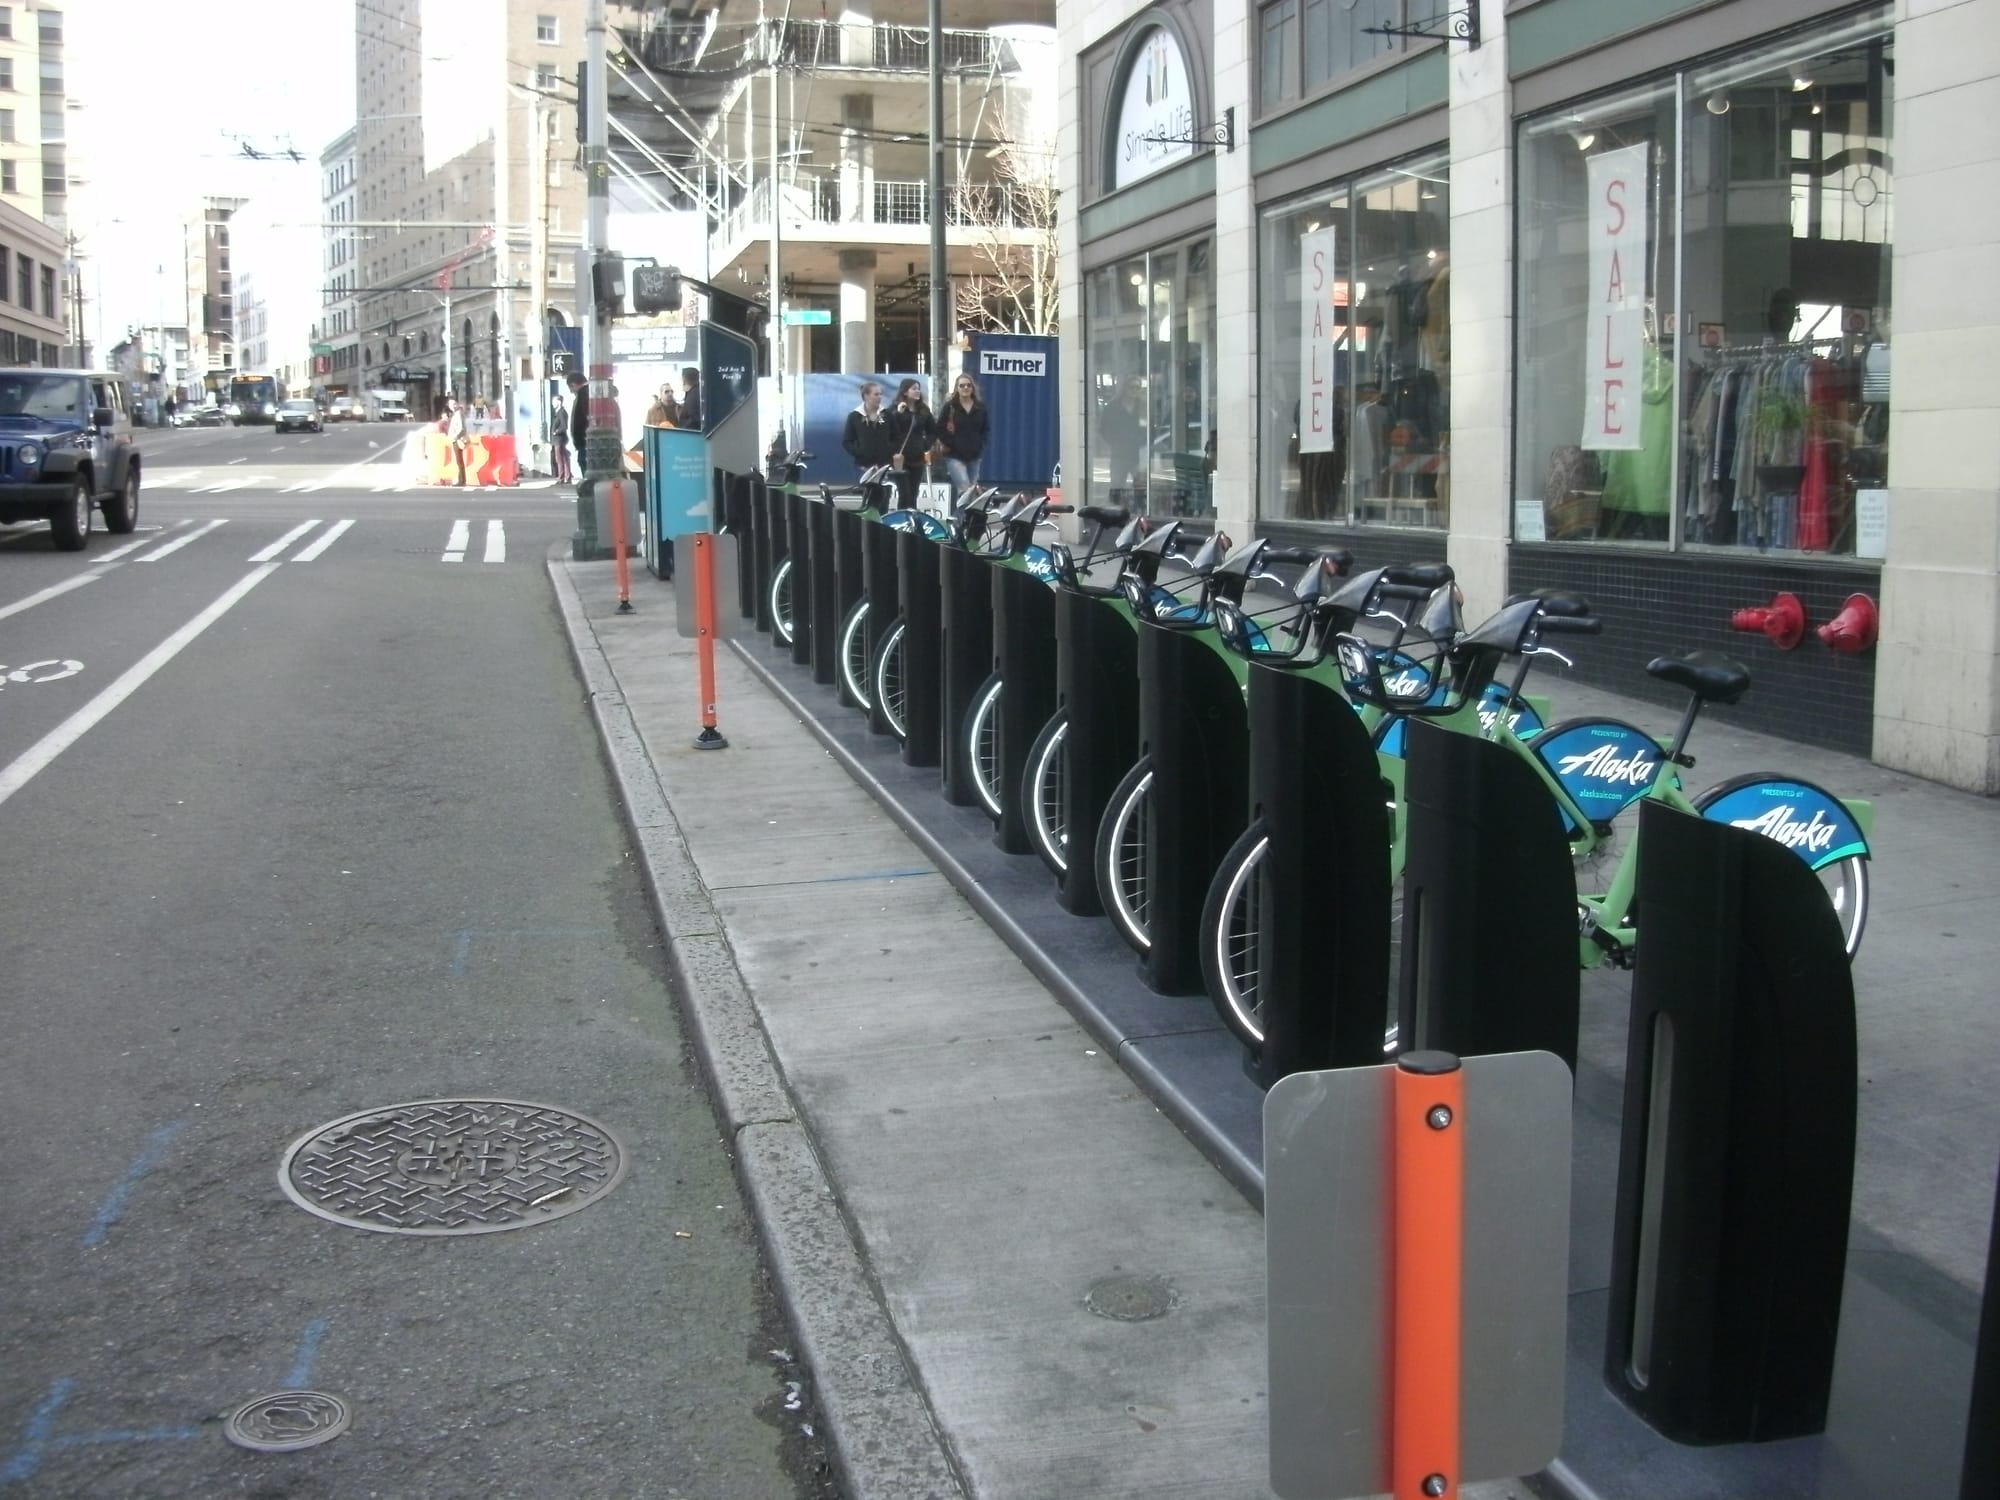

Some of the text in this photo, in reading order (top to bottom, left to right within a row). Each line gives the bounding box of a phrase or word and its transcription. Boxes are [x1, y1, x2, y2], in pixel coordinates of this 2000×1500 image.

[1126, 119, 1167, 162] Simple
[1169, 104, 1193, 141] Life
[1603, 180, 1625, 434] SALE
[1312, 251, 1324, 433] SALE
[983, 353, 1043, 373] Turner
[1591, 729, 1620, 738] PRESENTED
[1558, 744, 1655, 785] Alaska
[1761, 788, 1796, 798] PRESENTED
[1730, 804, 1838, 852] Alaska
[472, 1113, 576, 1152] WATER
